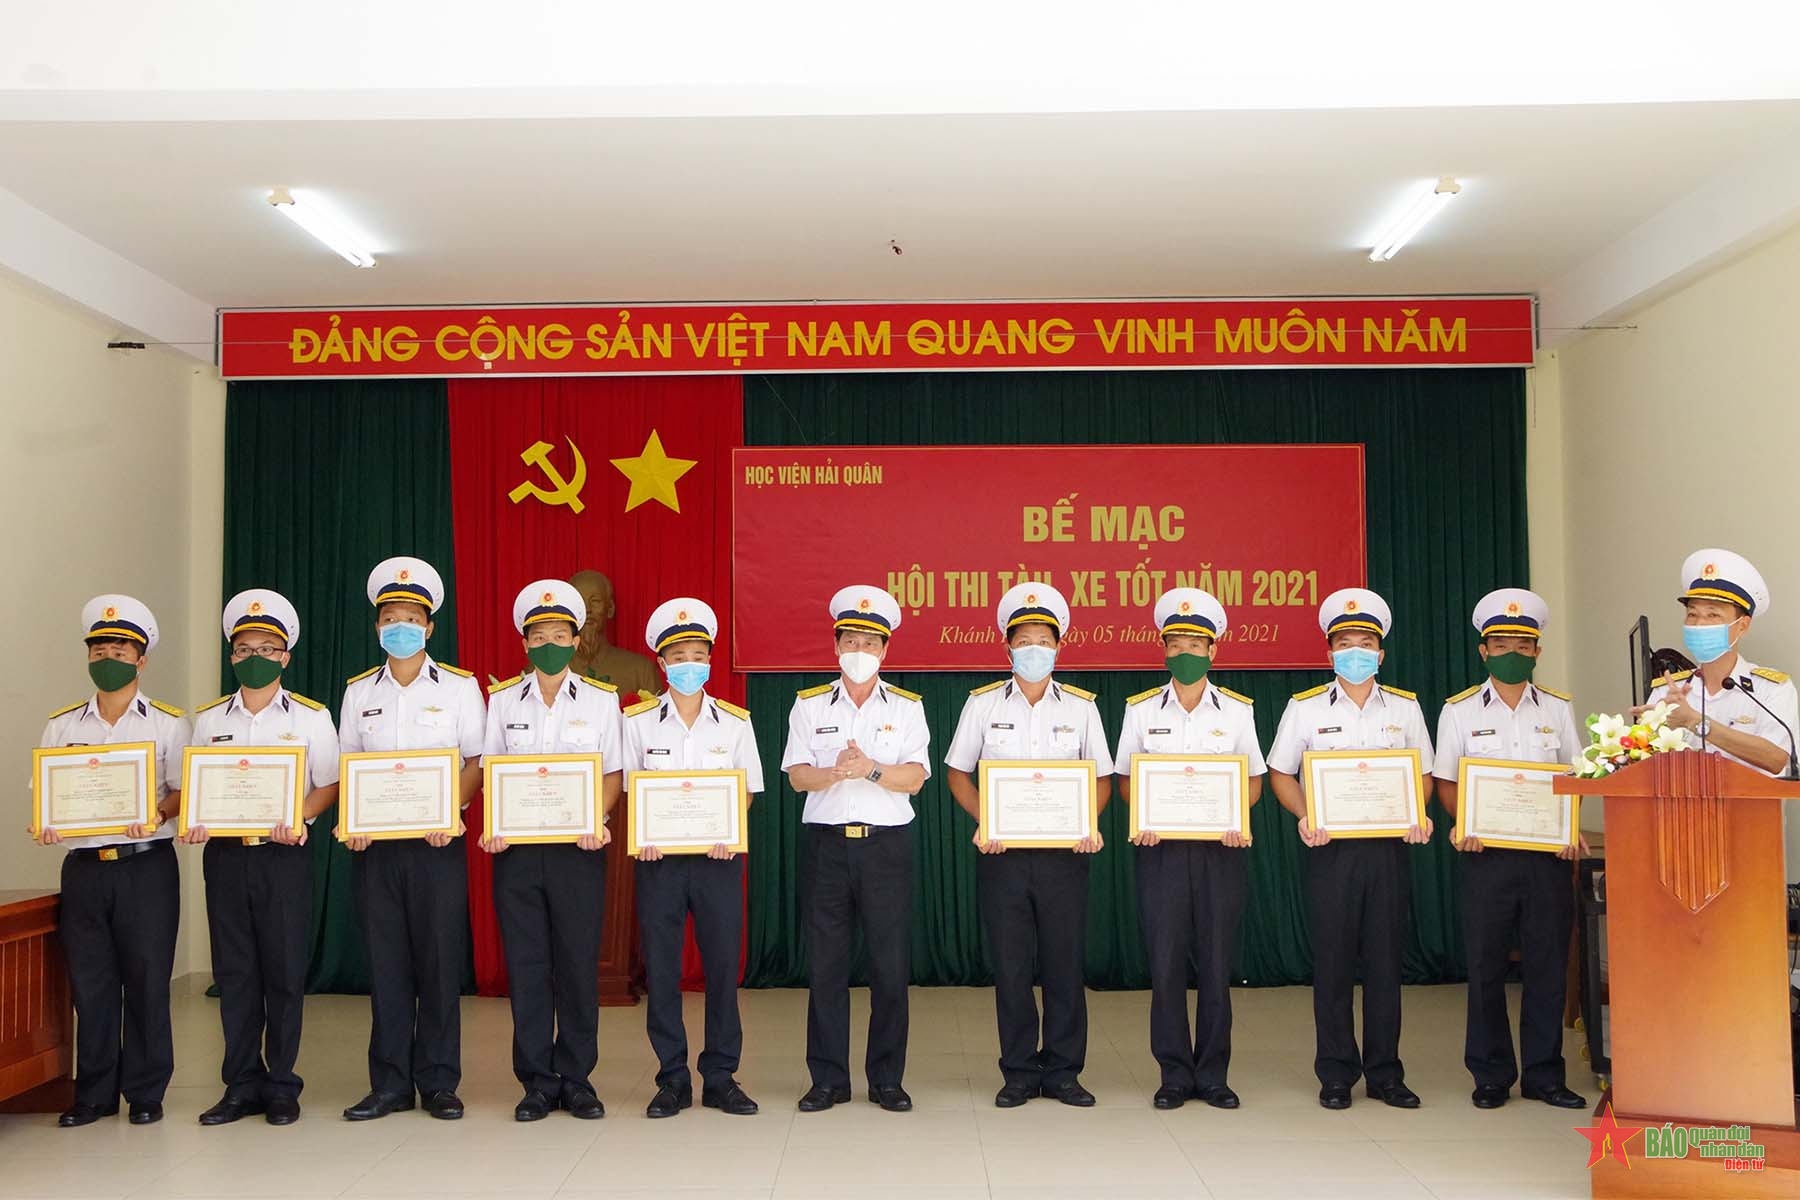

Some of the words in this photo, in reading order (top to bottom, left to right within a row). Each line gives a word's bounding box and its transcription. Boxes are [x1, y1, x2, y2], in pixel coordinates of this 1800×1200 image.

[289, 314, 420, 363] ĐẢNG
[435, 315, 573, 369] CỘNG
[585, 310, 672, 359] SẢN
[684, 312, 770, 366] VIỆT
[787, 320, 891, 357] NAM
[907, 318, 1075, 356] QUANG
[1093, 318, 1194, 354] VINH
[1215, 308, 1346, 354] MUÔN
[1364, 308, 1467, 353] NĂM
[745, 465, 774, 488] HỌC
[778, 461, 811, 488] VIỆN
[815, 458, 839, 485] HẢI
[843, 461, 883, 487] QUÂN
[1023, 493, 1077, 542] BẾ
[1091, 505, 1185, 550] MẠC
[887, 564, 935, 616] HỘI
[944, 571, 989, 608] THI
[1071, 571, 1106, 607] XE
[1115, 558, 1166, 607] TỐT
[1252, 570, 1318, 606] 2021
[940, 625, 996, 644] Khánh
[1093, 624, 1115, 643] 05
[1238, 624, 1279, 642] 2021
